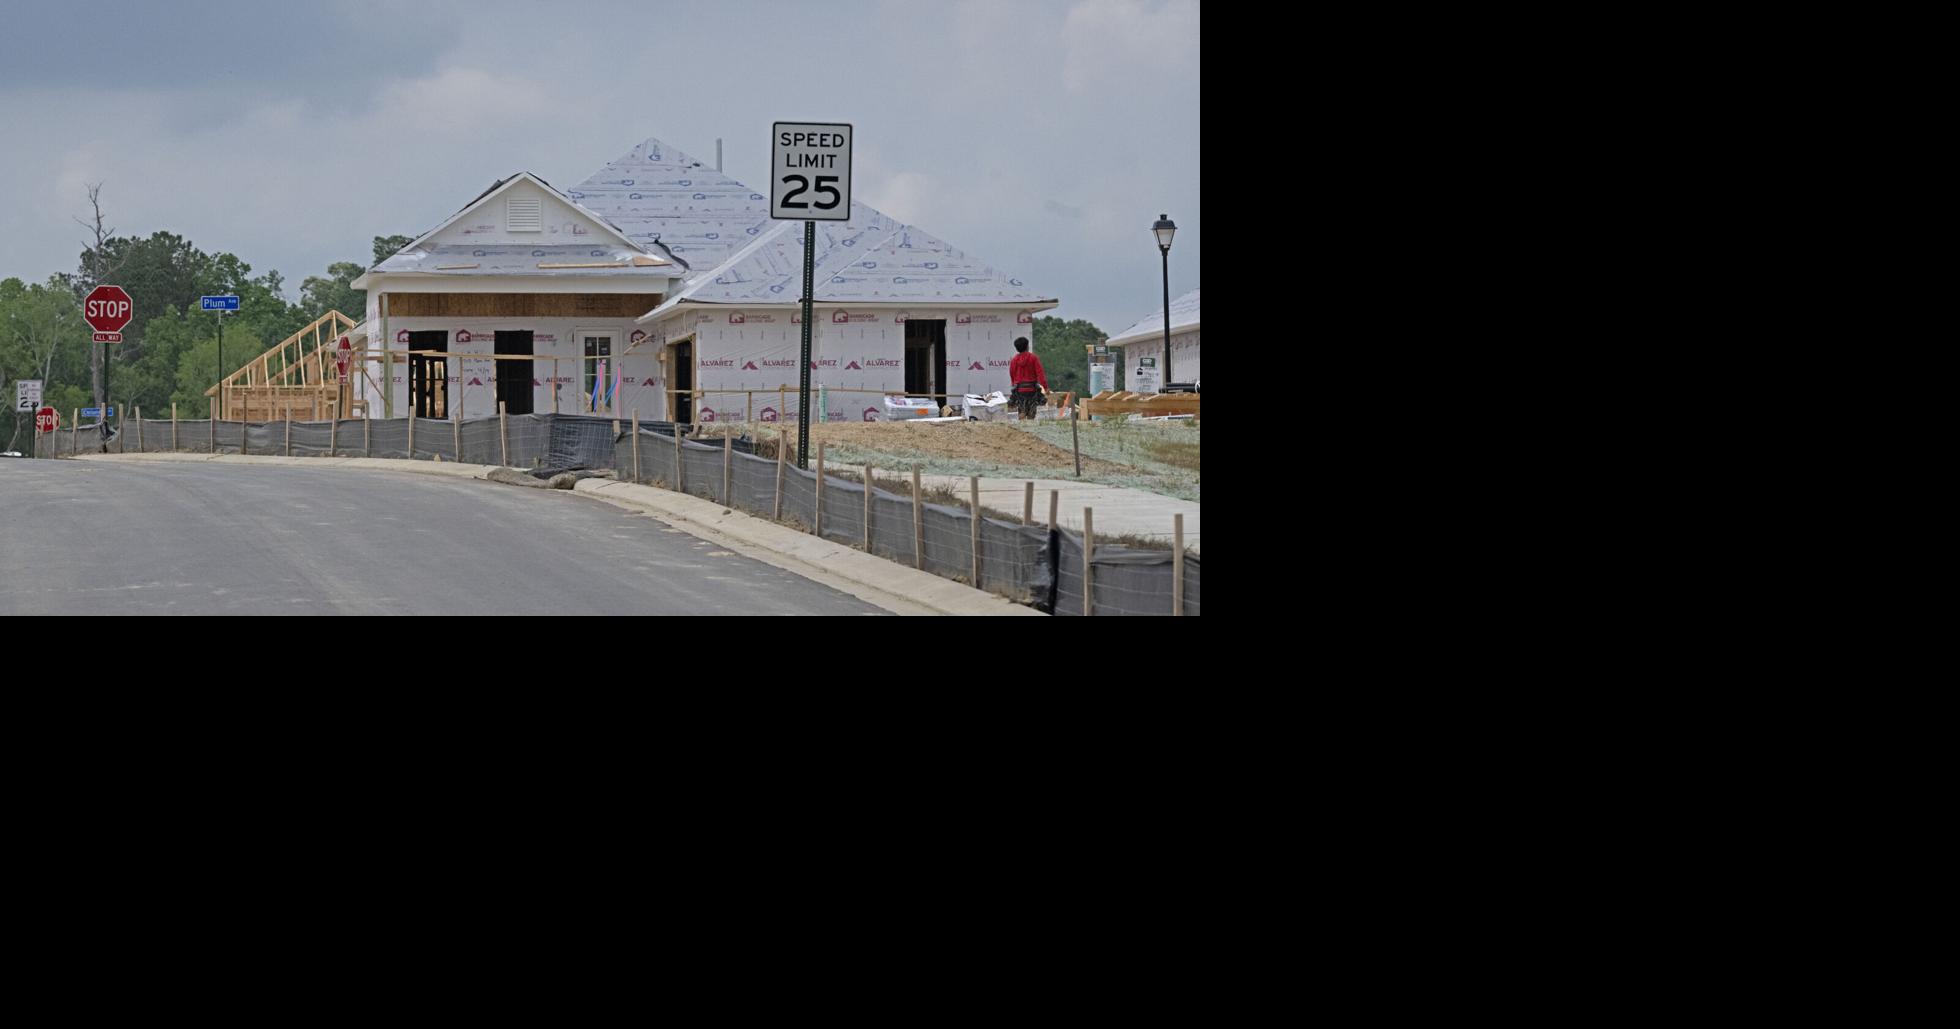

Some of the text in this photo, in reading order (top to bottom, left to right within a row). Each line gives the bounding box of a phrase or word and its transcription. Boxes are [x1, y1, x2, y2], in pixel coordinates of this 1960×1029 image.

[780, 132, 844, 148] SPEED
[786, 153, 837, 168] LIMIT
[780, 174, 841, 210] 25
[88, 300, 129, 318] STOP
[204, 298, 226, 308] Plum
